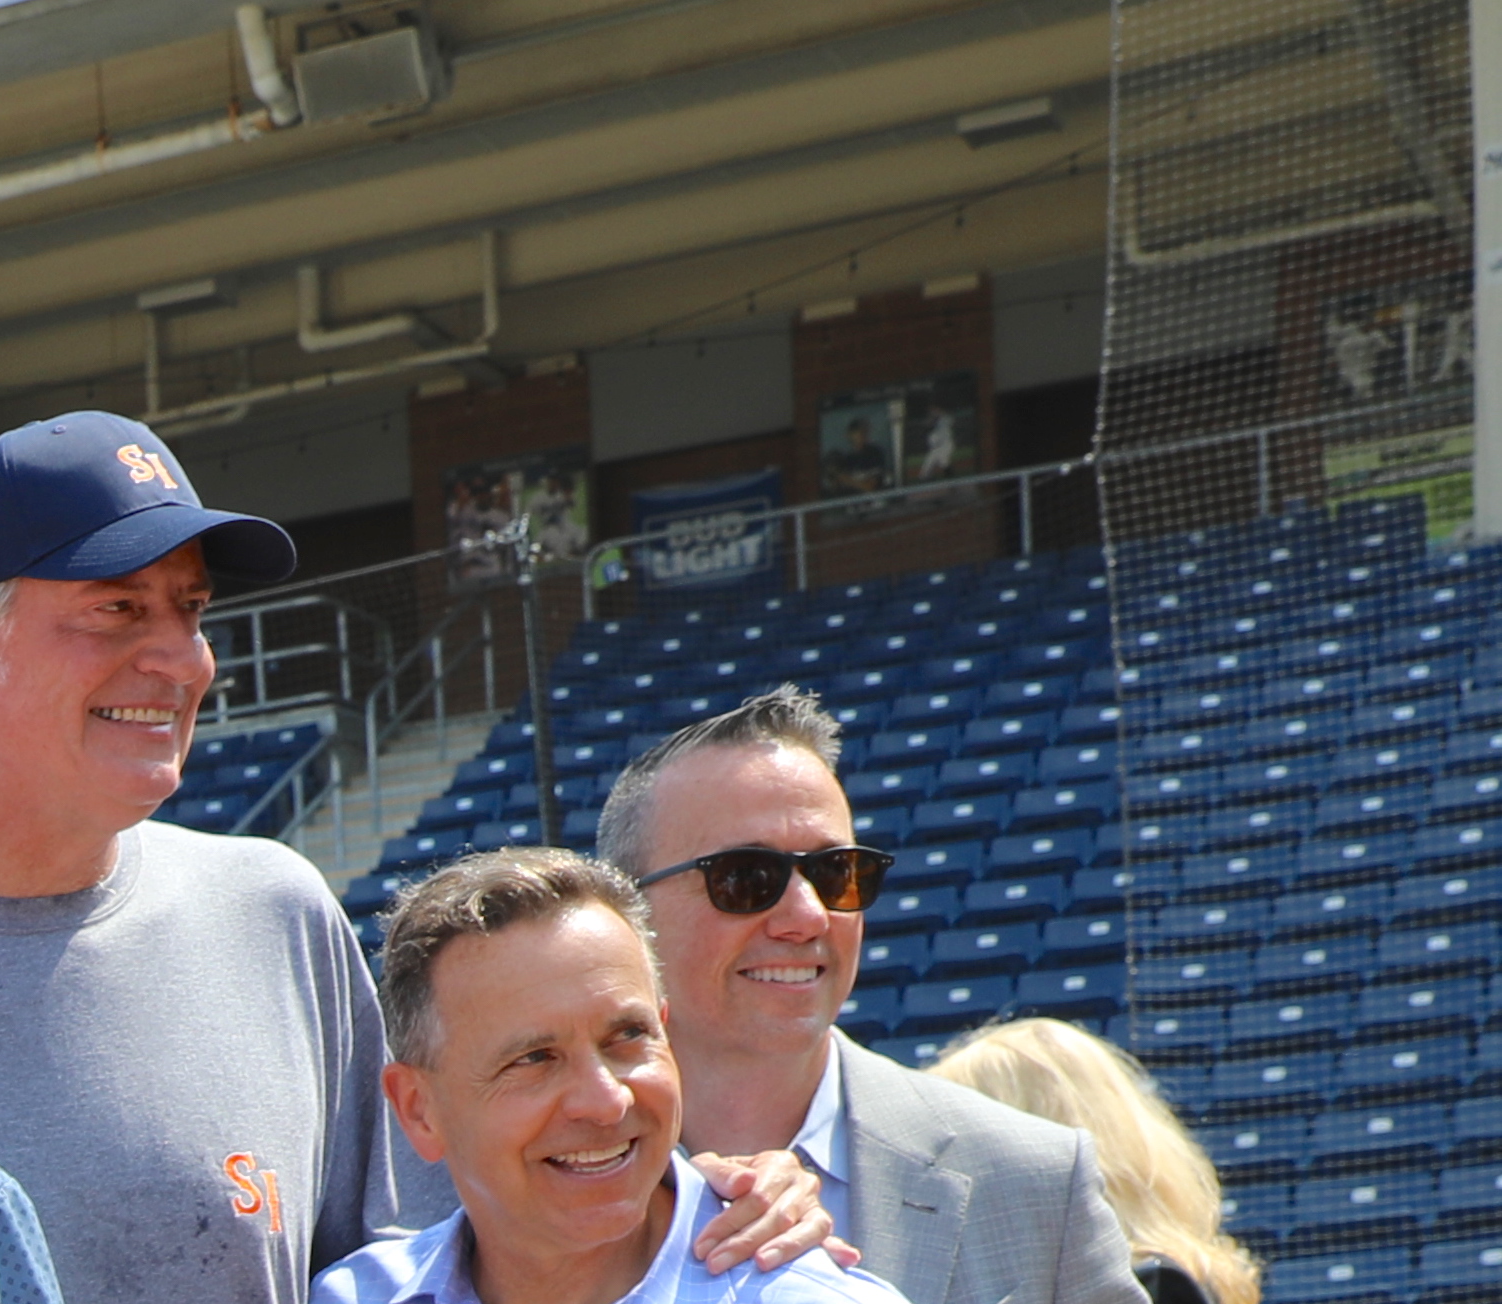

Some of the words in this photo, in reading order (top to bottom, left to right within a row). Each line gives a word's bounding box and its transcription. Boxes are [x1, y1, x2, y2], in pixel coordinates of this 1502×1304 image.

[117, 444, 179, 490] SI
[652, 534, 765, 579] LIGHT
[223, 1151, 283, 1234] SI
